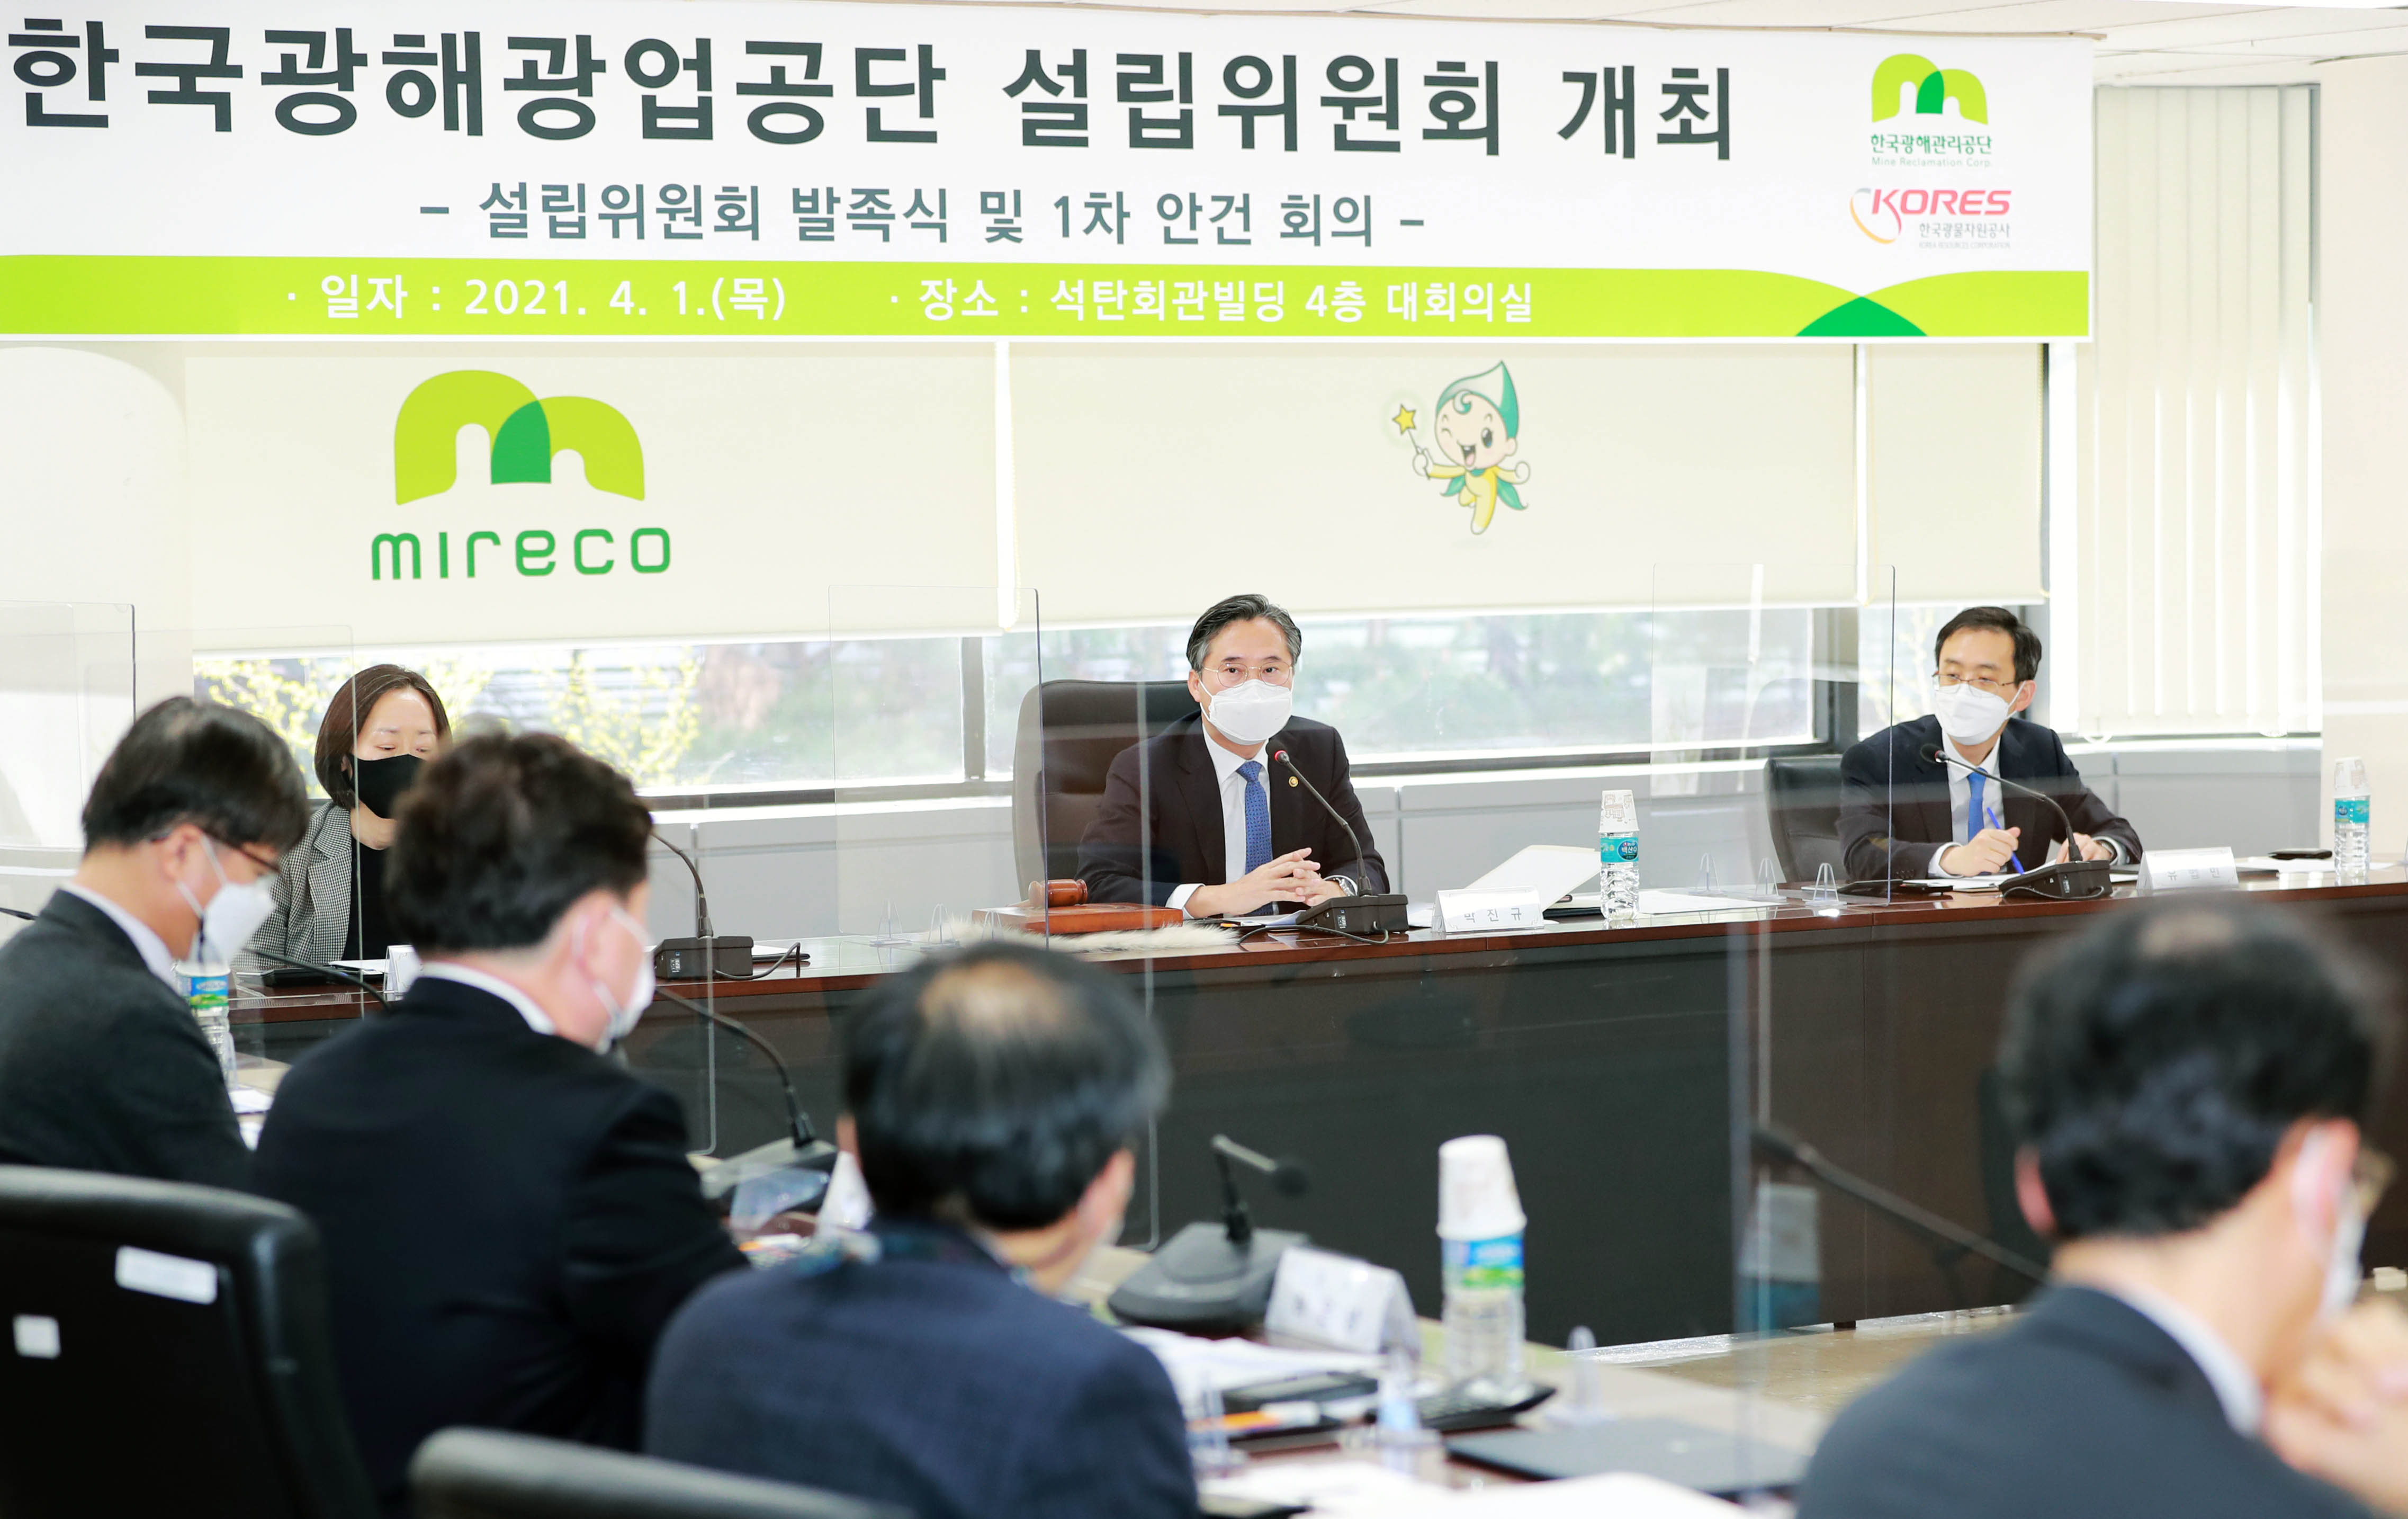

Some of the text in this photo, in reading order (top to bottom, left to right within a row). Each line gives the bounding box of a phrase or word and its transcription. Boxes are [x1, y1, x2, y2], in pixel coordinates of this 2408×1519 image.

[8, 17, 1730, 161] 한국광해광업공단 설립위원회 개최
[1871, 134, 1992, 155] 한국광해관리공단
[1872, 157, 1993, 168] Mine Reclamation Corp.
[479, 182, 760, 242] 설립위원회
[792, 186, 947, 243] 발족식
[980, 189, 1023, 244] 및
[1054, 191, 1130, 245] 1차
[1156, 192, 1252, 246] 안건
[1280, 194, 1372, 248] 회의
[1872, 189, 2012, 227] KORES
[1919, 222, 2010, 239] 한국광물자원공사
[321, 274, 409, 319] 일자
[465, 279, 586, 316] 2021.
[609, 280, 647, 316] 4.
[672, 277, 786, 321] 1.(목)
[919, 278, 999, 321] 장소
[1050, 279, 1284, 323] 석탄회관빌딩
[1305, 281, 1367, 323] 4층
[1387, 282, 1532, 323] 대회의실
[372, 528, 670, 580] mireco
